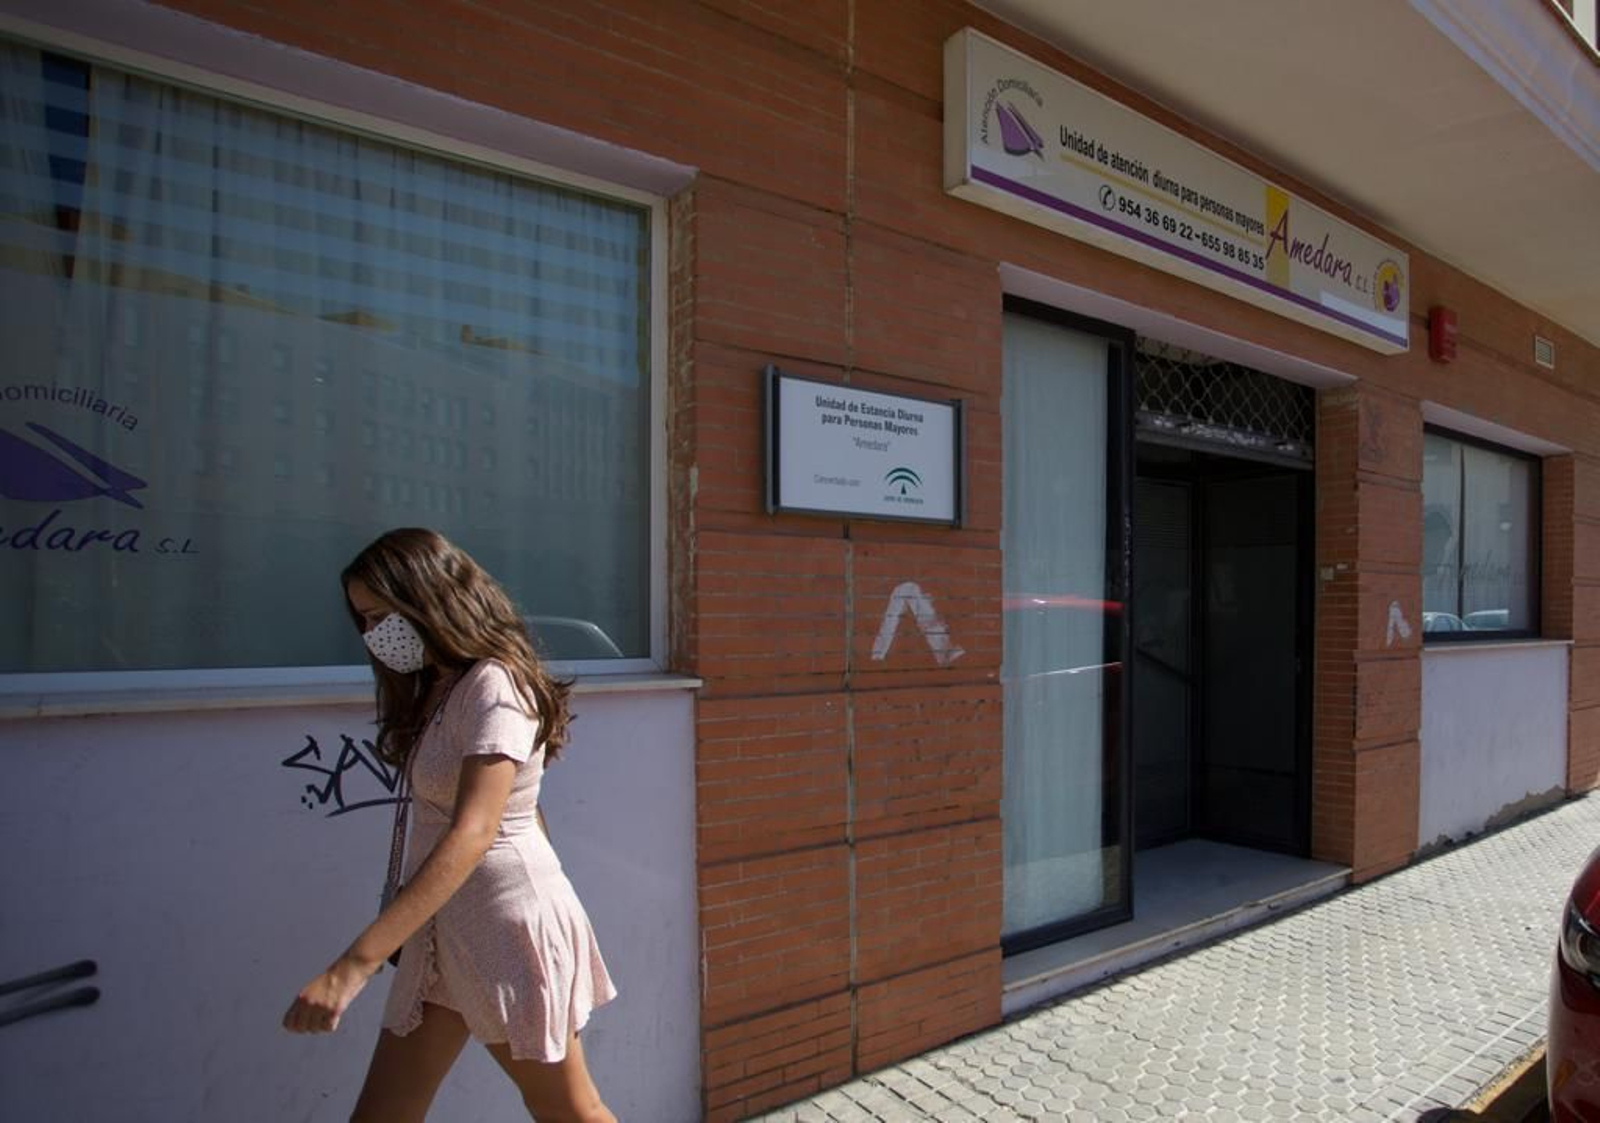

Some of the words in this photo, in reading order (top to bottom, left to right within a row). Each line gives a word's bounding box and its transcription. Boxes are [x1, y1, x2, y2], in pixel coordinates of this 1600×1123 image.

[1060, 125, 1095, 159] Unidad
[1097, 144, 1109, 165] de
[1111, 152, 1149, 184] atención
[1153, 170, 1180, 197] diurna
[1181, 186, 1199, 207] para
[1200, 195, 1234, 222] personas
[1235, 212, 1265, 237] mayores
[1118, 196, 1142, 219] 954
[1144, 208, 1160, 226] 36
[1162, 215, 1176, 233] 69
[1222, 241, 1236, 259] 98
[1237, 248, 1250, 265] 85
[1252, 254, 1265, 270] 35
[1266, 209, 1353, 287] Amedara
[0, 383, 138, 431] omiciliaria
[815, 396, 846, 411] Unidad
[848, 402, 859, 413] de
[861, 404, 896, 420] Estancia
[897, 408, 924, 423] Diurna
[821, 413, 843, 426] para
[844, 415, 883, 431] Personas
[884, 419, 918, 436] Mayores
